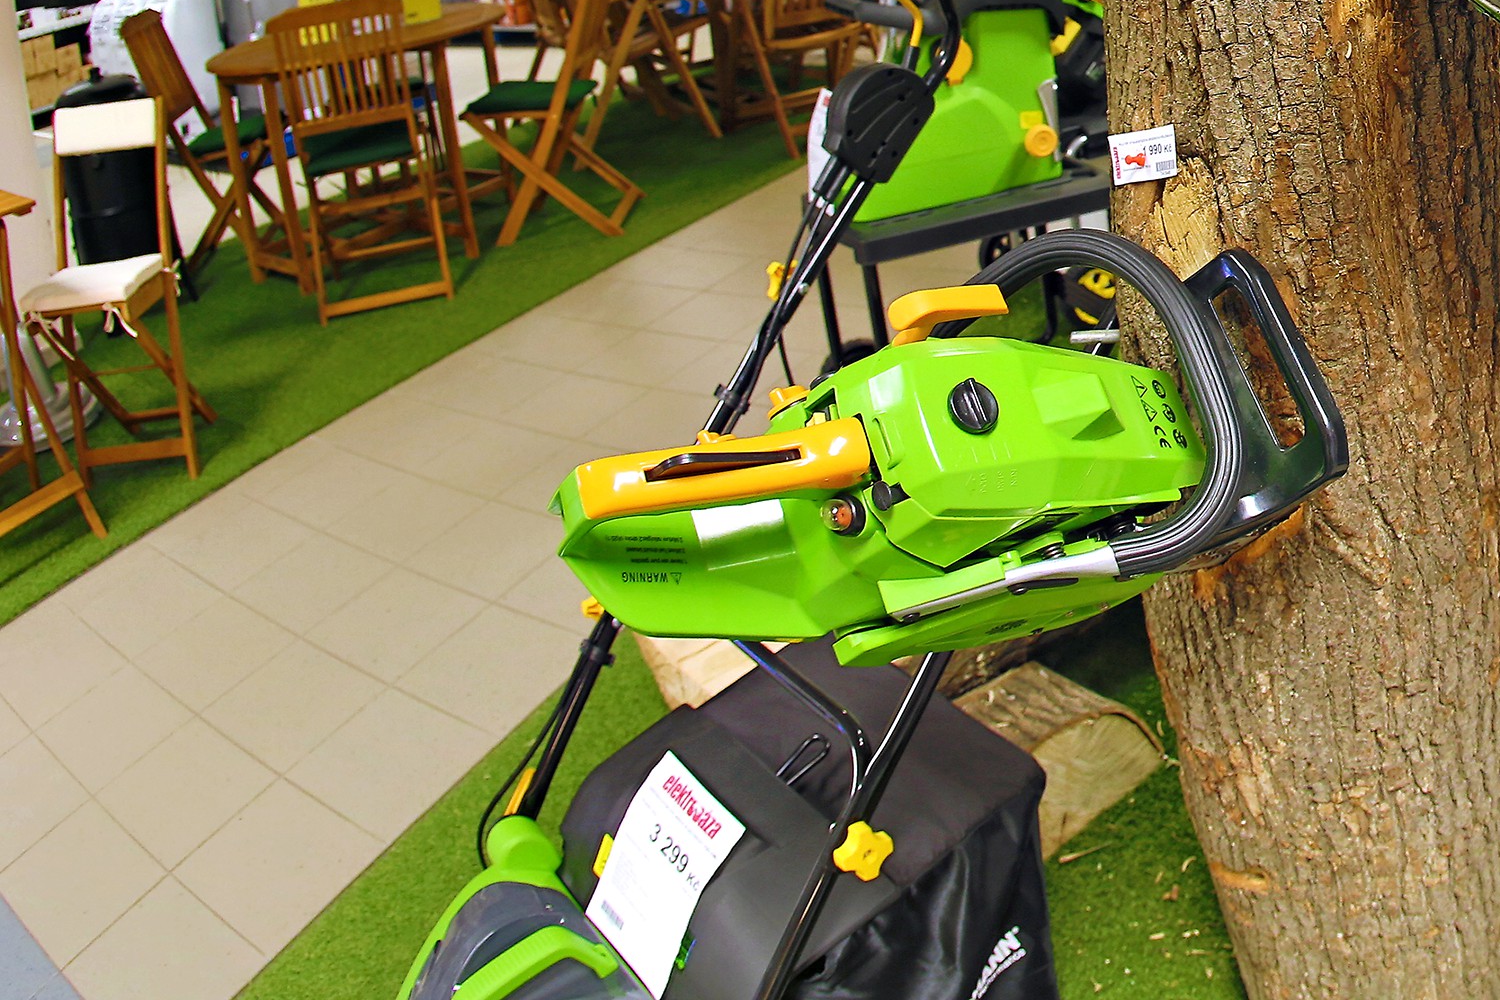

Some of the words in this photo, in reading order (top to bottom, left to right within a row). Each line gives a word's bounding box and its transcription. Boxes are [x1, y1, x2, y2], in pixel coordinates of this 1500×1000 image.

[622, 571, 668, 583] WARNING
[649, 823, 662, 843] 3
[660, 836, 689, 873] 299
